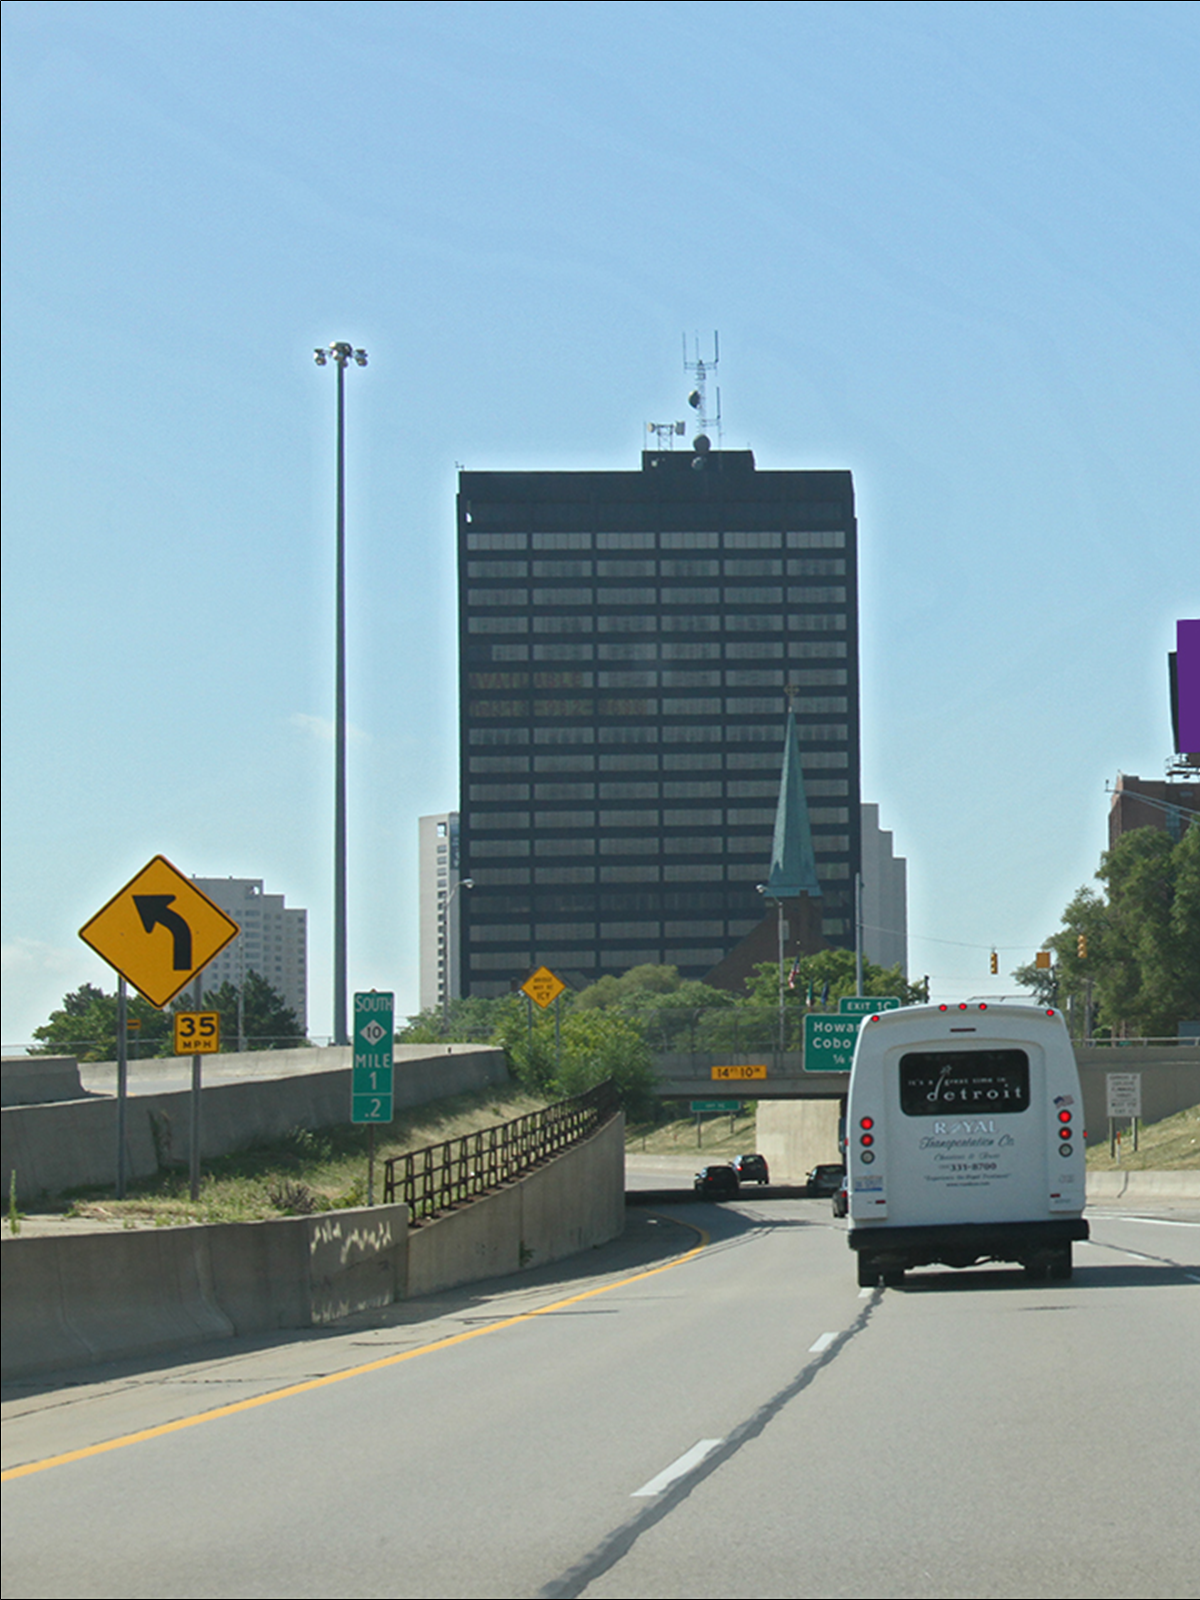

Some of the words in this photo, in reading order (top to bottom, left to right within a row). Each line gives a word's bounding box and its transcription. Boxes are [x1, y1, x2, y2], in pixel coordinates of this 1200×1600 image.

[355, 995, 393, 1012] SOUTH
[847, 1002, 871, 1011] EXIT
[877, 1001, 892, 1011] 1C
[180, 1017, 215, 1037] 35
[366, 1026, 382, 1039] 10
[183, 1041, 211, 1049] MPH
[813, 1037, 851, 1049] Cobo
[355, 1053, 391, 1068] MILE
[369, 1071, 377, 1090] 1
[926, 1075, 1022, 1101] detroit
[365, 1098, 381, 1117] .2
